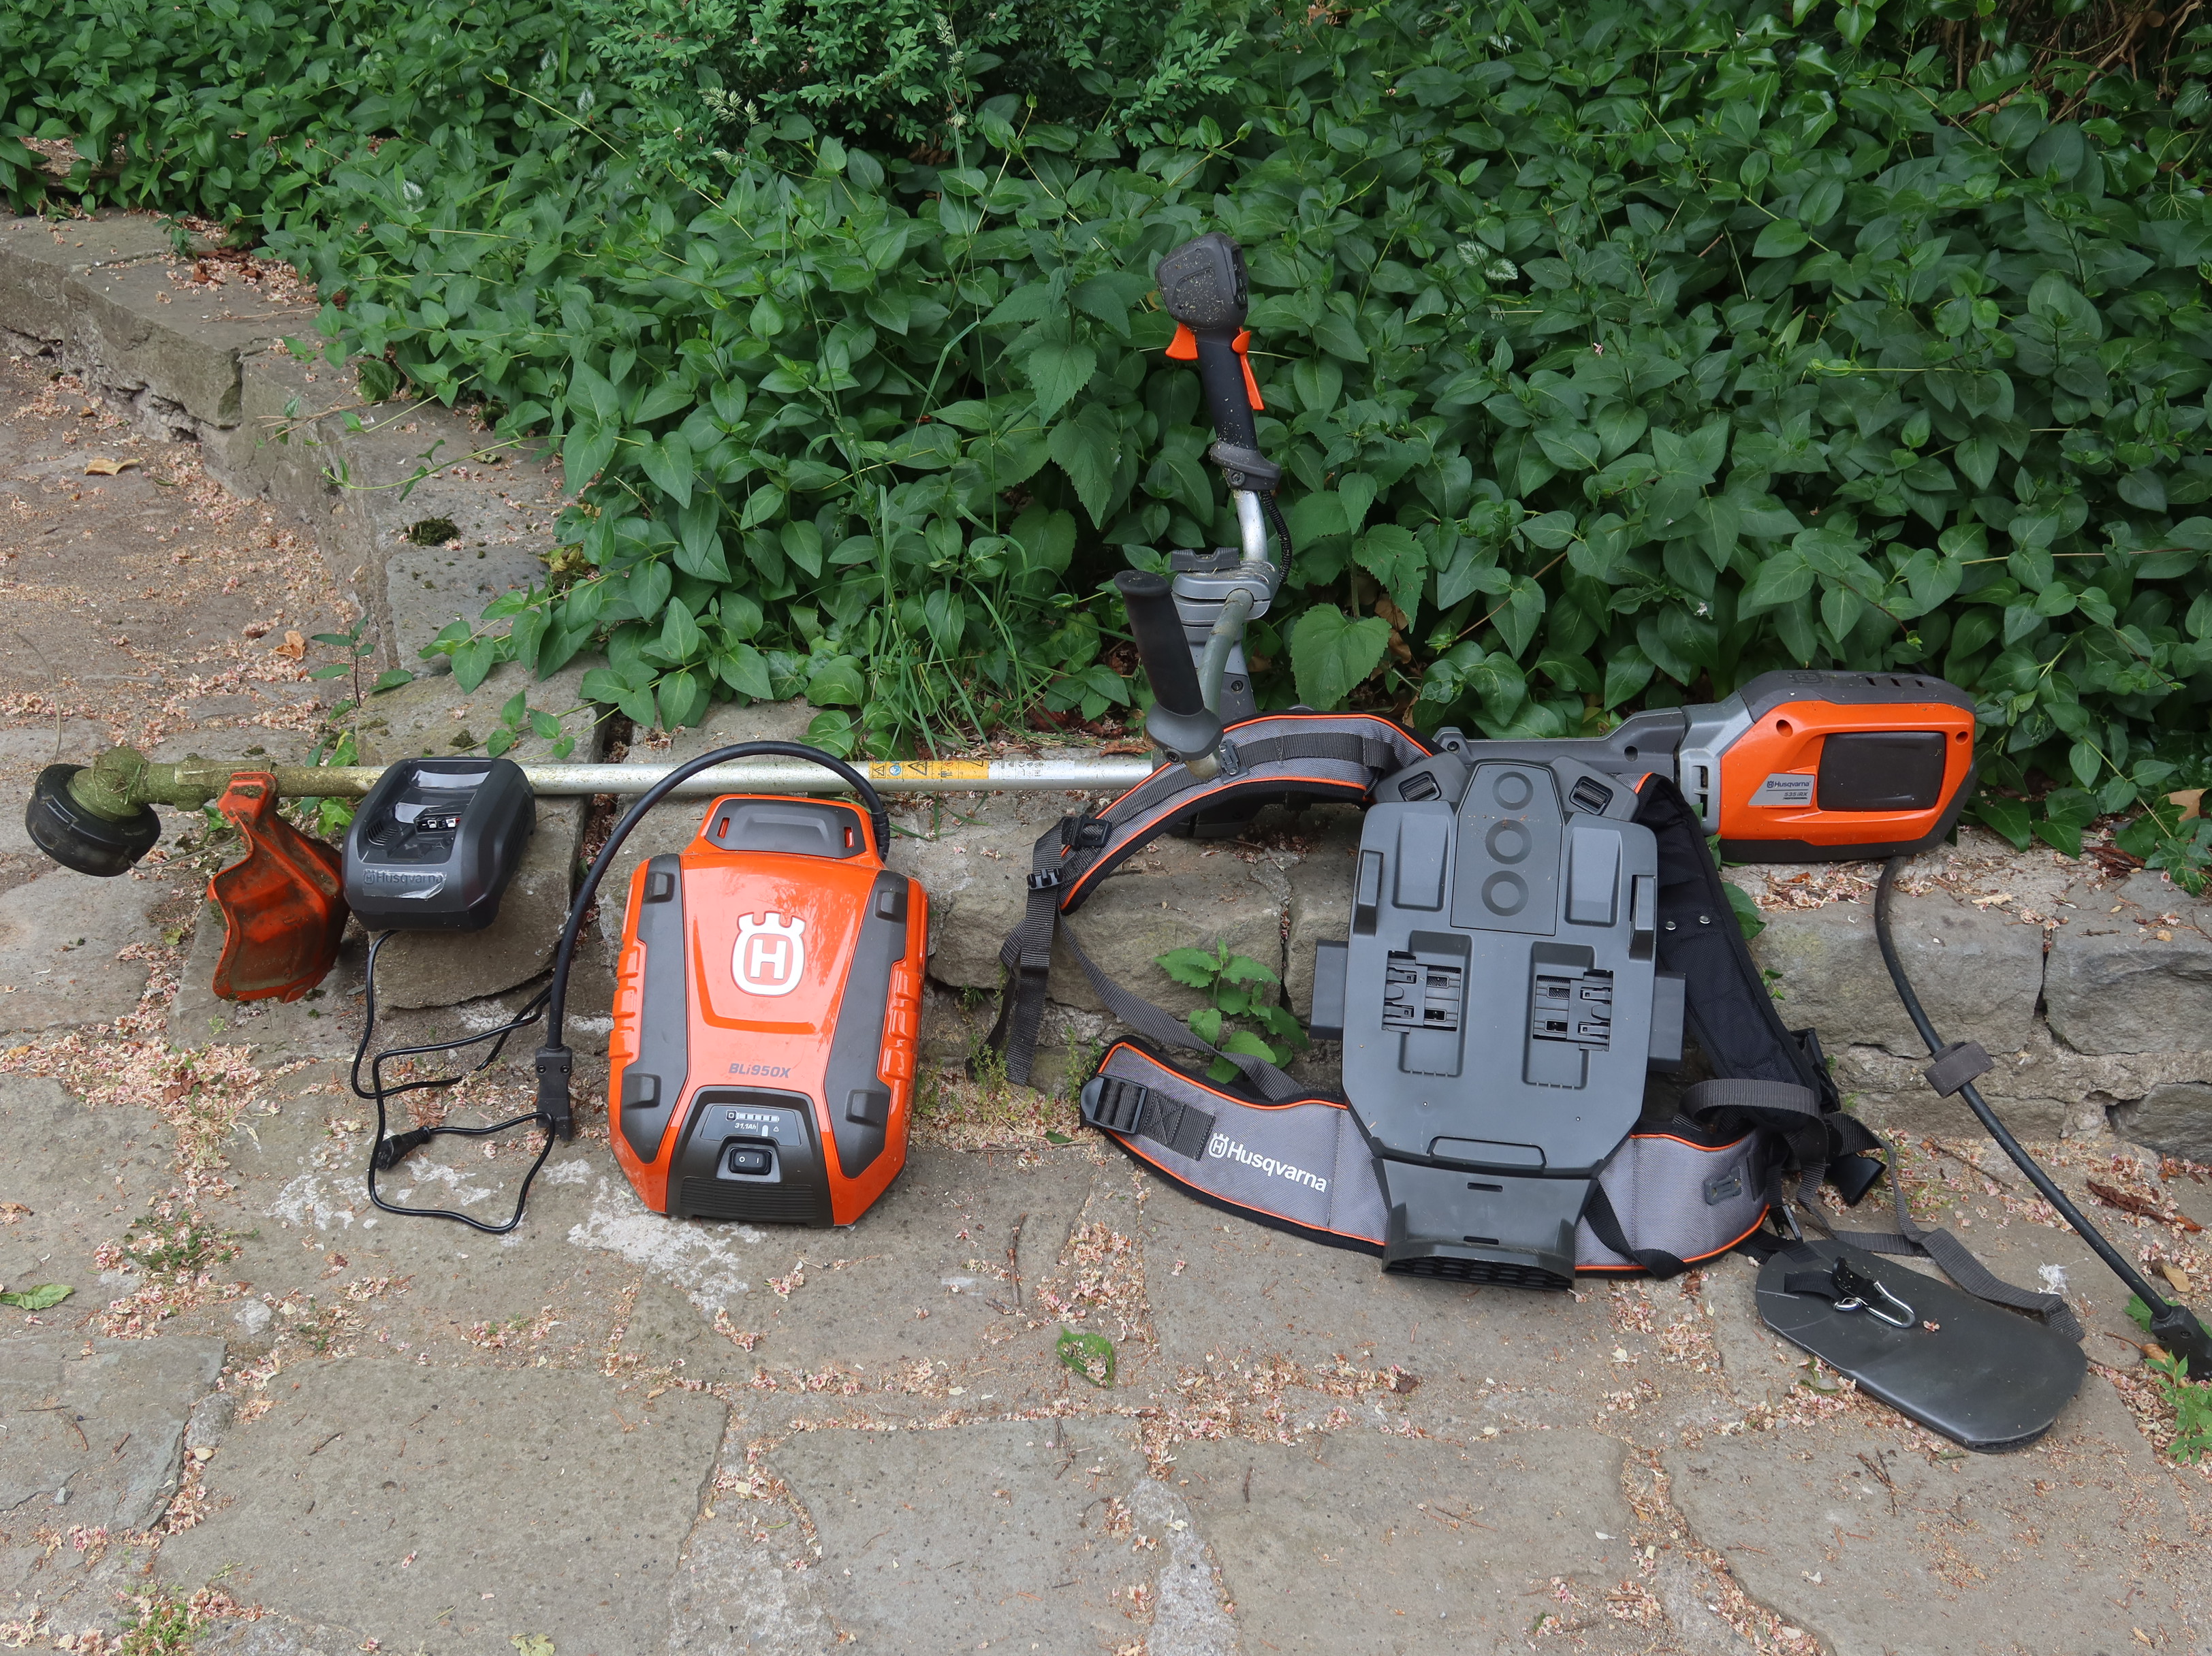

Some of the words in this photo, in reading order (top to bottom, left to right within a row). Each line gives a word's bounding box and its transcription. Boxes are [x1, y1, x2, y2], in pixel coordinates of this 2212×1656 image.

[377, 872, 443, 885] Husqvarna
[729, 1063, 791, 1079] BLi950X
[735, 1122, 757, 1130] 31,1Ah
[1227, 1141, 1327, 1192] Husqvarna
